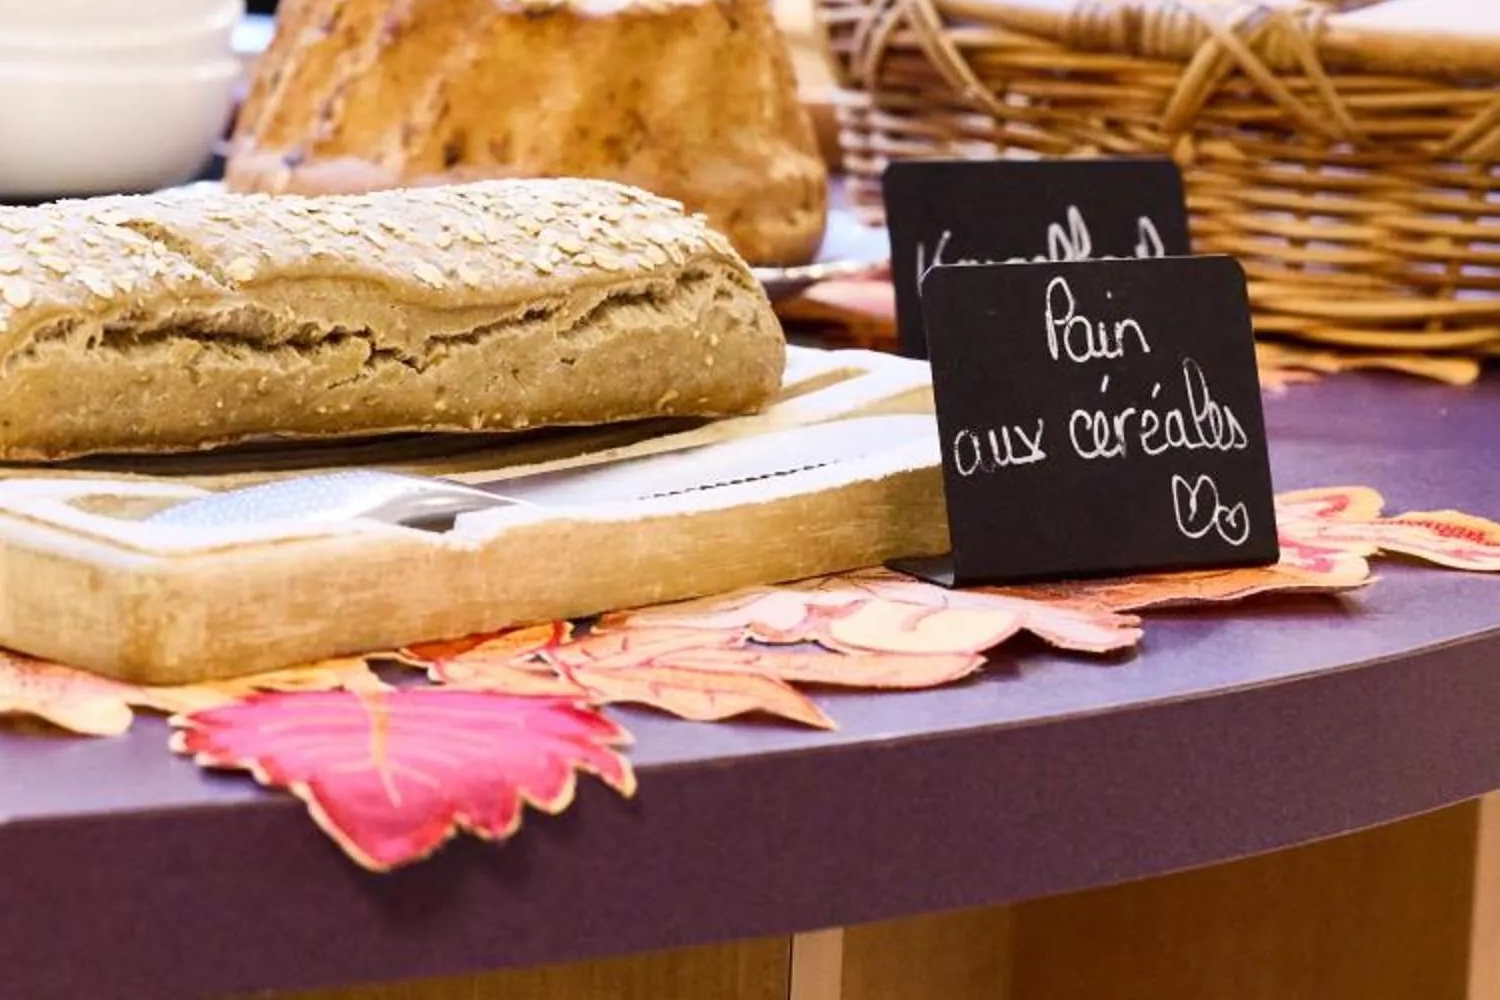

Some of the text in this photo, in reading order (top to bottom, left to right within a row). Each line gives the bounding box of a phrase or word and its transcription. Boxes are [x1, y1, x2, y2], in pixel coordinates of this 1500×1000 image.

[1044, 275, 1151, 363] Pain
[953, 357, 1250, 476] aux céréales
